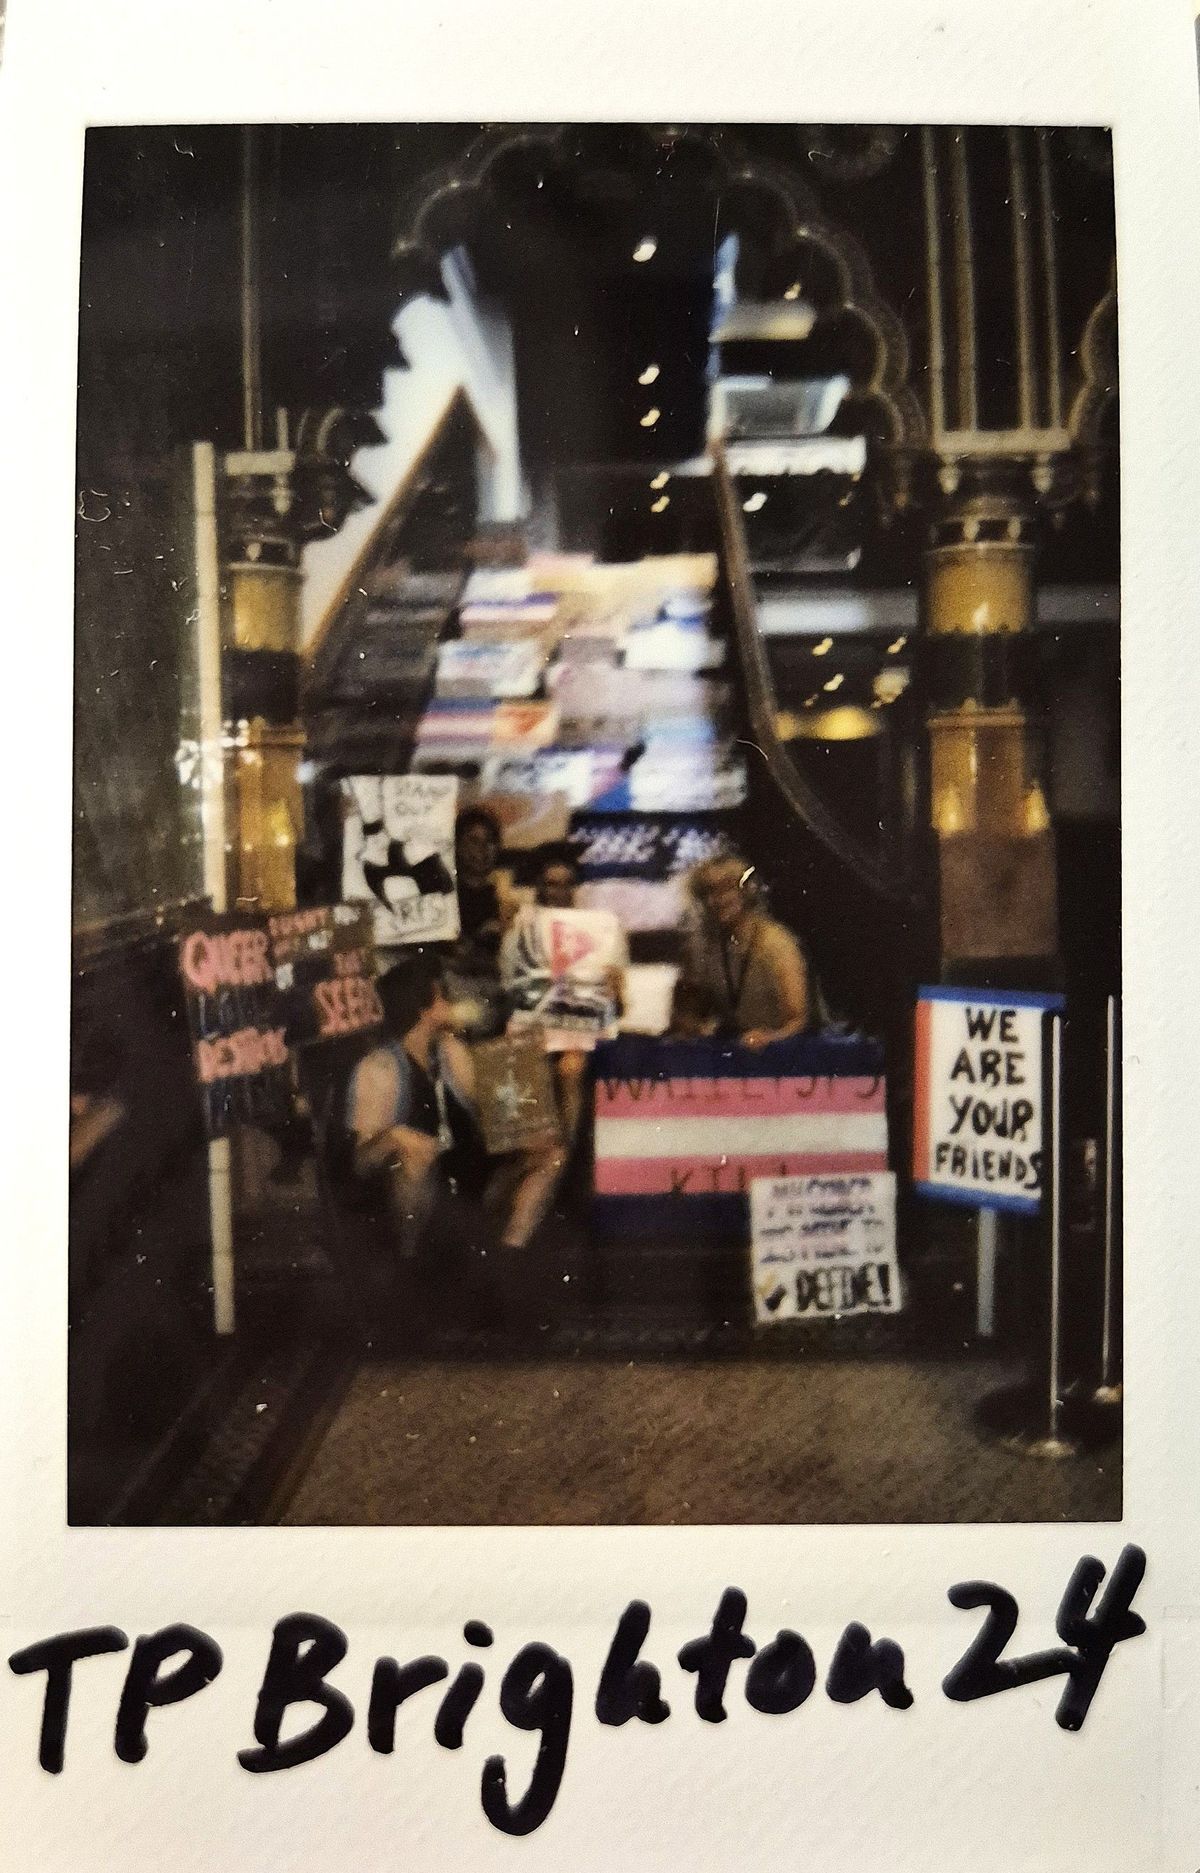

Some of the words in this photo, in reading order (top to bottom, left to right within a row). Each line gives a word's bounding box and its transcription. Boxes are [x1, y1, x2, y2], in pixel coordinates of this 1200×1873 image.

[965, 1006, 1019, 1043] WE
[950, 1047, 1026, 1087] ARE
[949, 1095, 1034, 1142] YOUR
[934, 1142, 1043, 1189] FRIENDS
[8, 1622, 223, 1775] TP
[237, 1587, 915, 1837] Brighton
[943, 1545, 1147, 1732] 24
